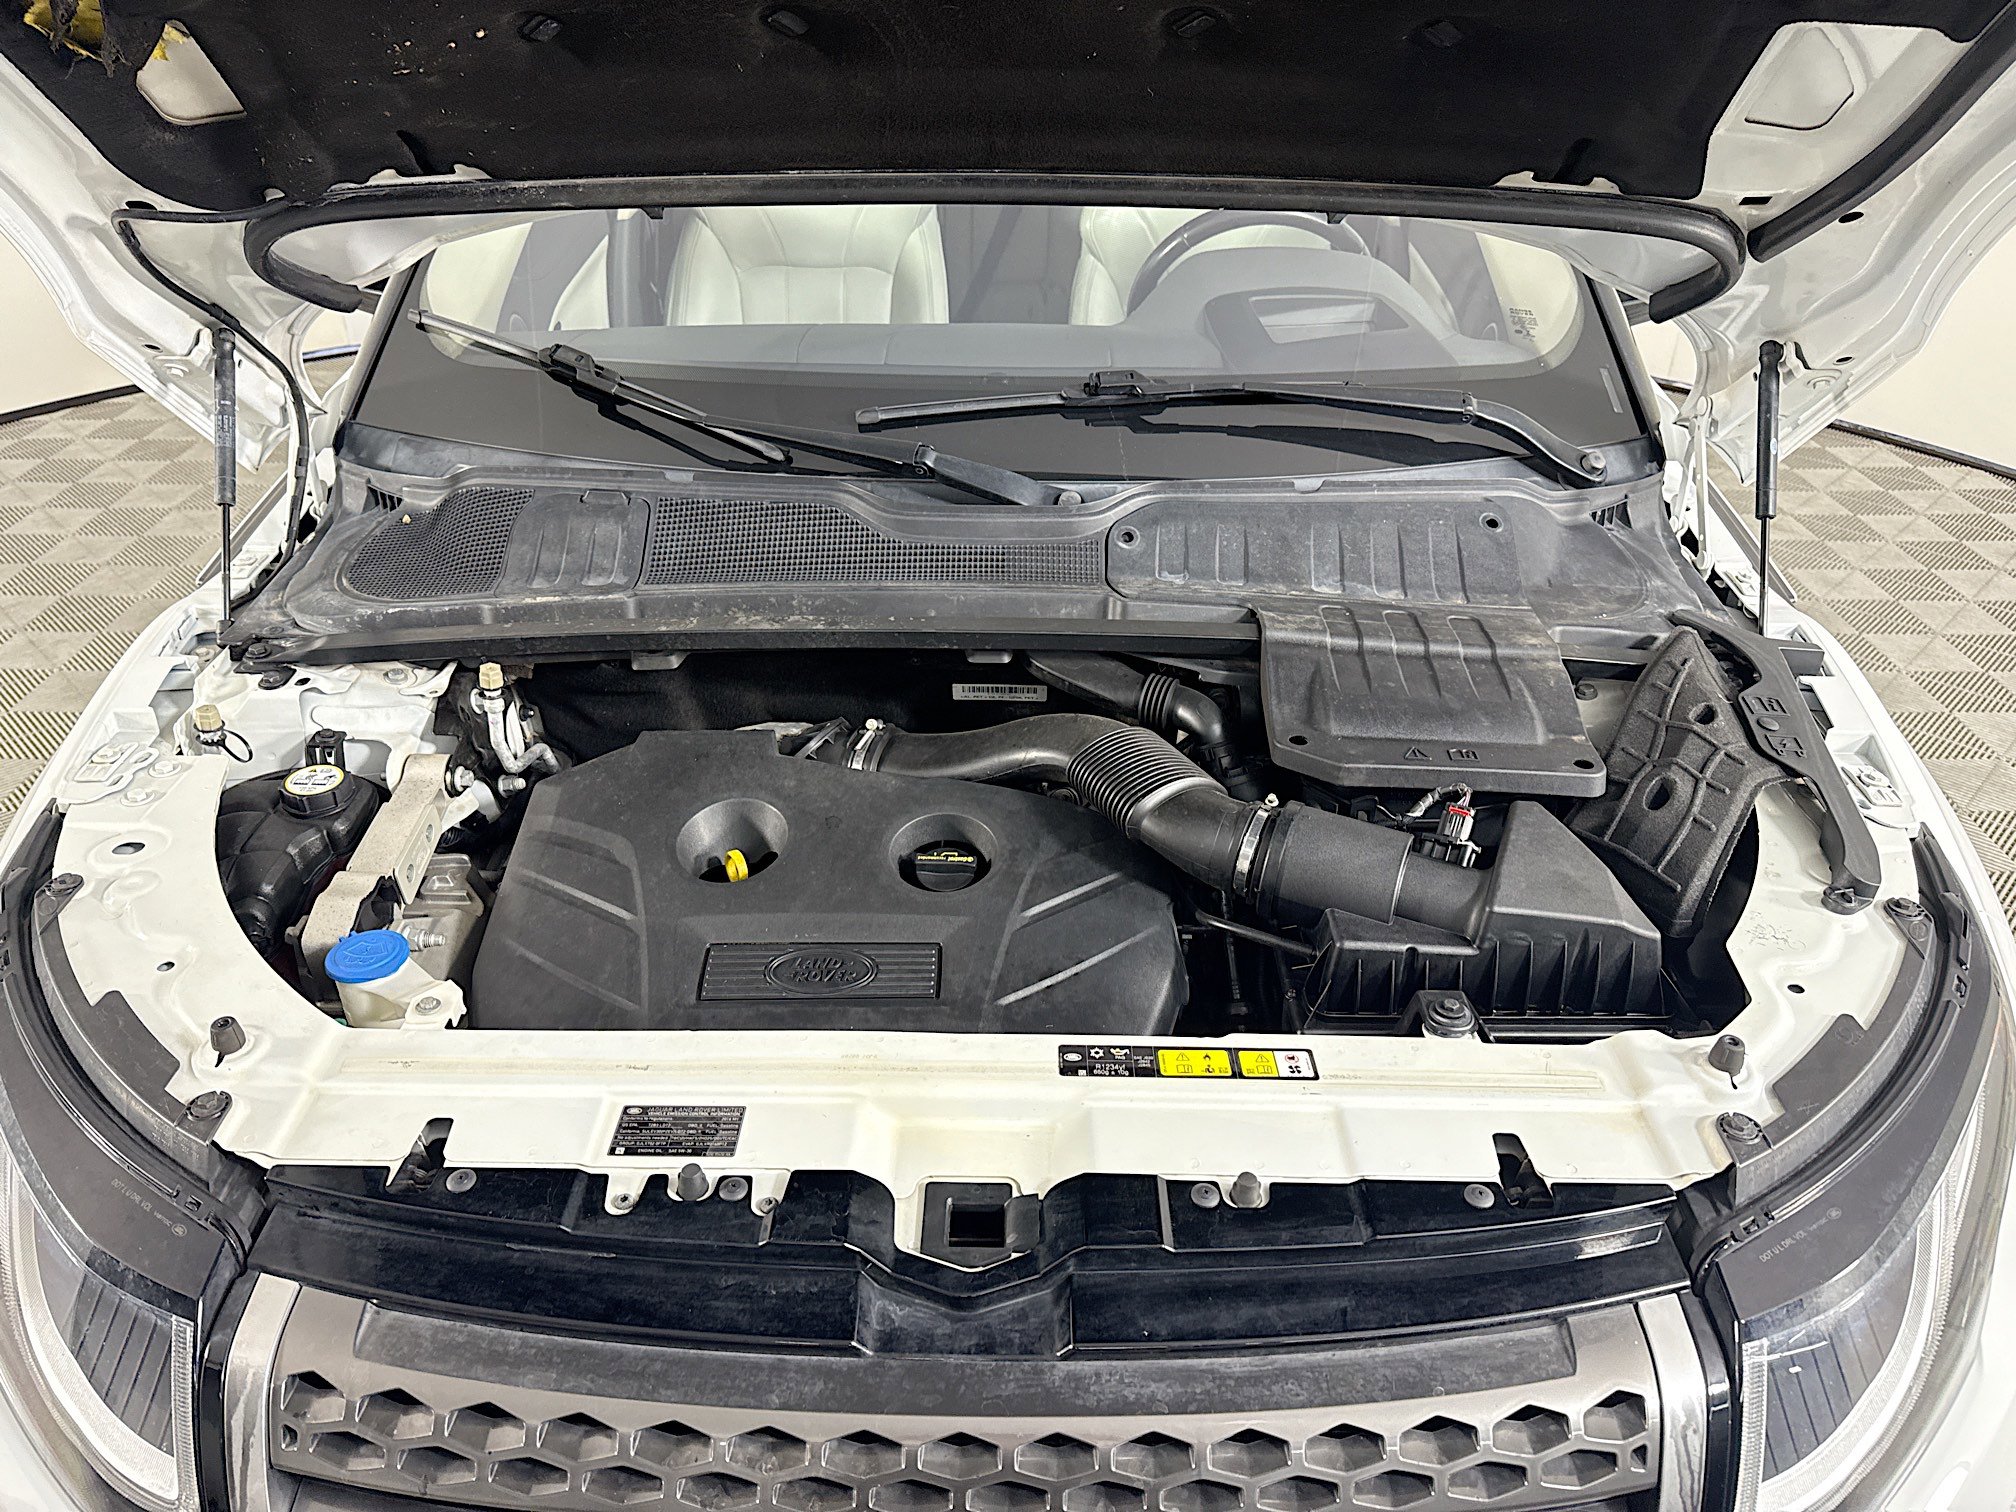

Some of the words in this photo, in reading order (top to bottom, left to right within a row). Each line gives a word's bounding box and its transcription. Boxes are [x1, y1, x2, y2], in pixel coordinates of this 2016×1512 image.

[792, 956, 842, 970] LAND
[795, 969, 858, 983] ROVER
[1759, 1250, 1774, 1262] DOT
